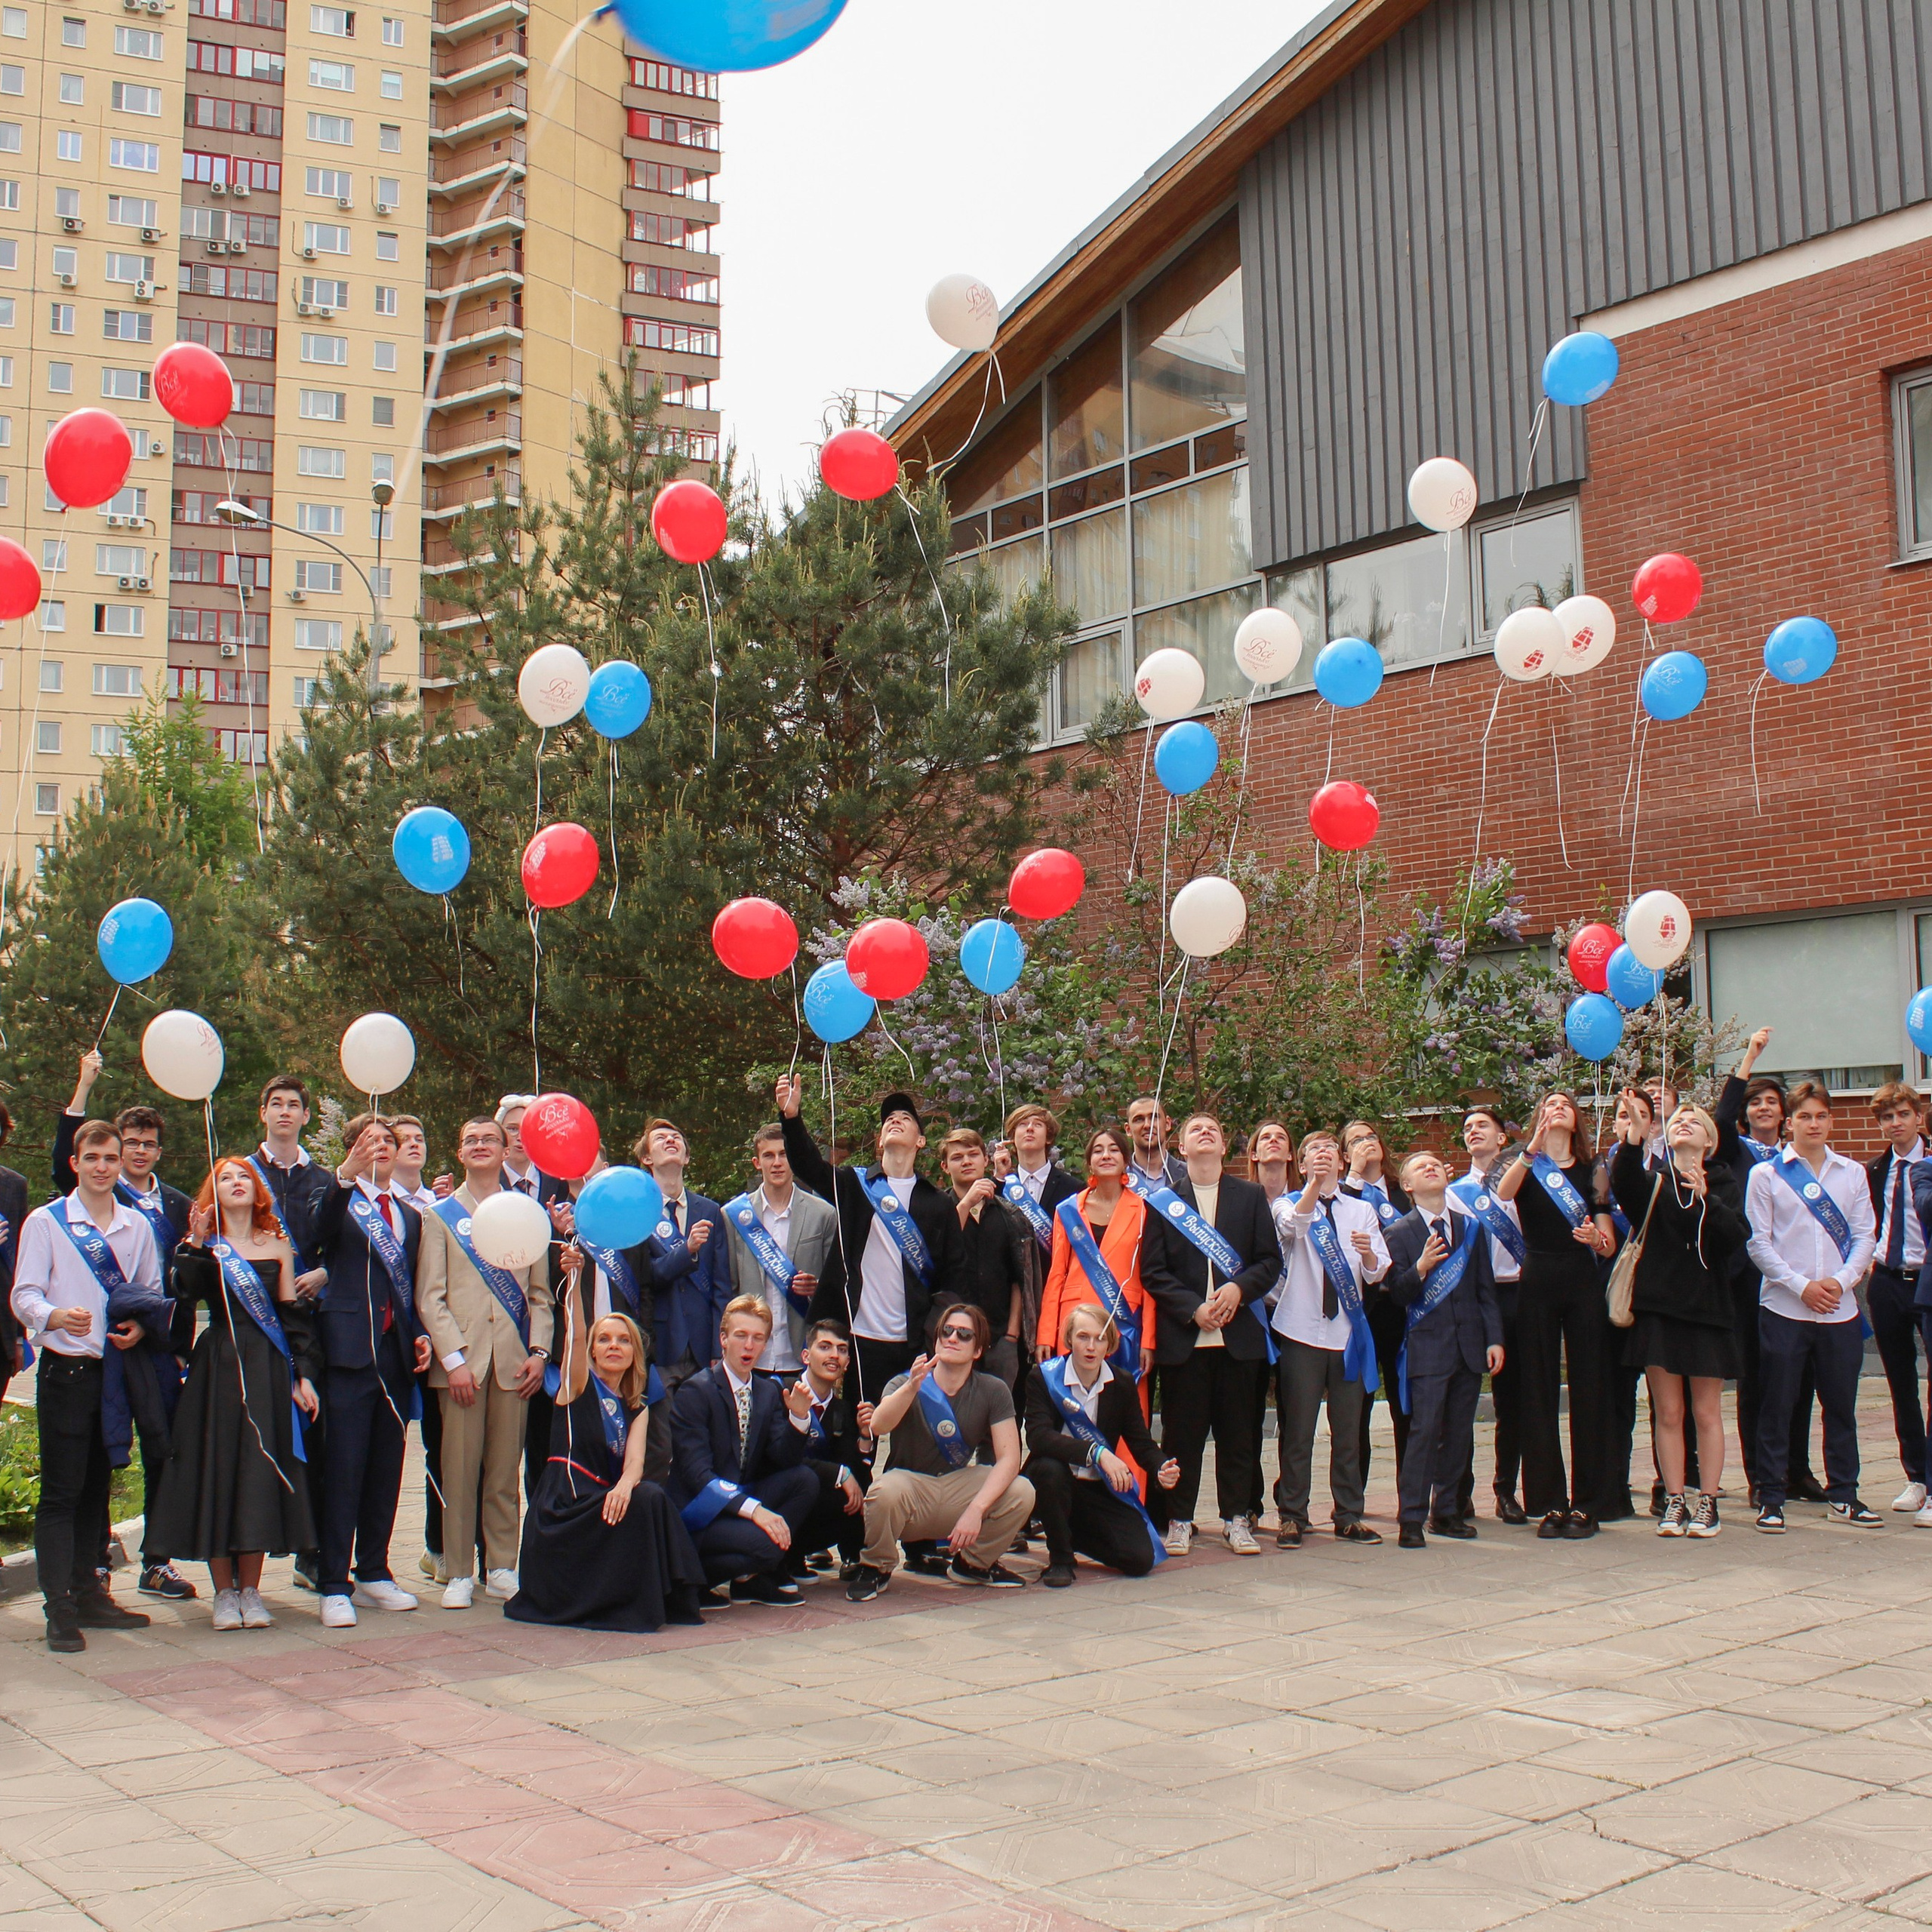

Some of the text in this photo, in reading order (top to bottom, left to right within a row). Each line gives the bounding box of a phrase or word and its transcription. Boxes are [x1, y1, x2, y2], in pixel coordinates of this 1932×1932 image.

[1243, 638, 1277, 659] Всё
[1654, 664, 1683, 685] Всё
[540, 678, 578, 700] Всё
[595, 684, 629, 703] Всё
[1577, 940, 1606, 955] Всё
[807, 981, 835, 1004] Всё
[1569, 1014, 1592, 1029] Всё
[538, 1103, 568, 1131] Всё
[366, 1218, 405, 1283] Выпускник
[1182, 1215, 1232, 1267] Выпускник
[748, 1226, 791, 1284] Выпускник
[1314, 1225, 1349, 1287] Выпускник
[225, 1257, 267, 1321] Выпускница
